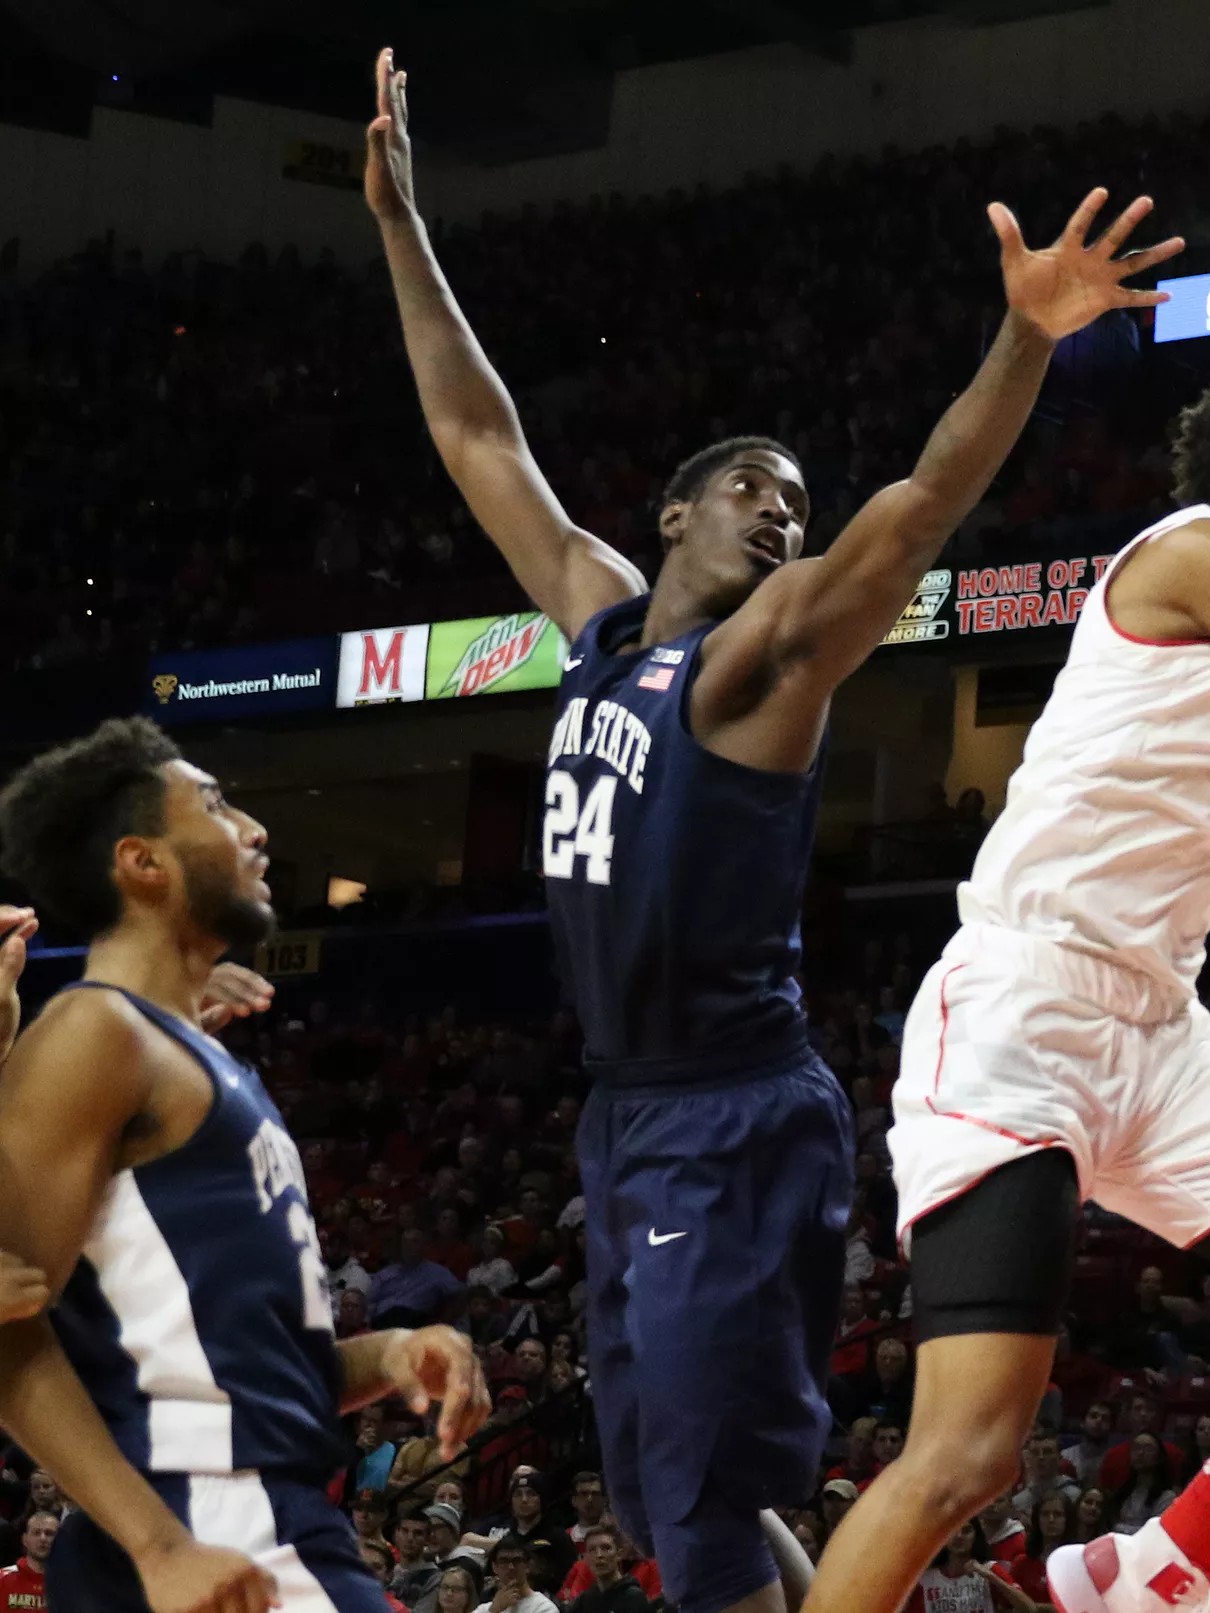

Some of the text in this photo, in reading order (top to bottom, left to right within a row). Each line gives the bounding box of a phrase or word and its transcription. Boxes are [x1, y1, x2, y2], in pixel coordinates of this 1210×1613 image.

[918, 572, 946, 589] DIO
[958, 563, 1042, 599] HOME
[1048, 557, 1087, 590] OF
[956, 587, 1091, 635] TERRAP
[884, 625, 938, 642] MORE
[356, 627, 407, 697] M
[177, 668, 322, 700] Northwestern Mutual
[584, 699, 652, 795] STATE
[542, 769, 618, 886] 24
[267, 945, 308, 973] 103
